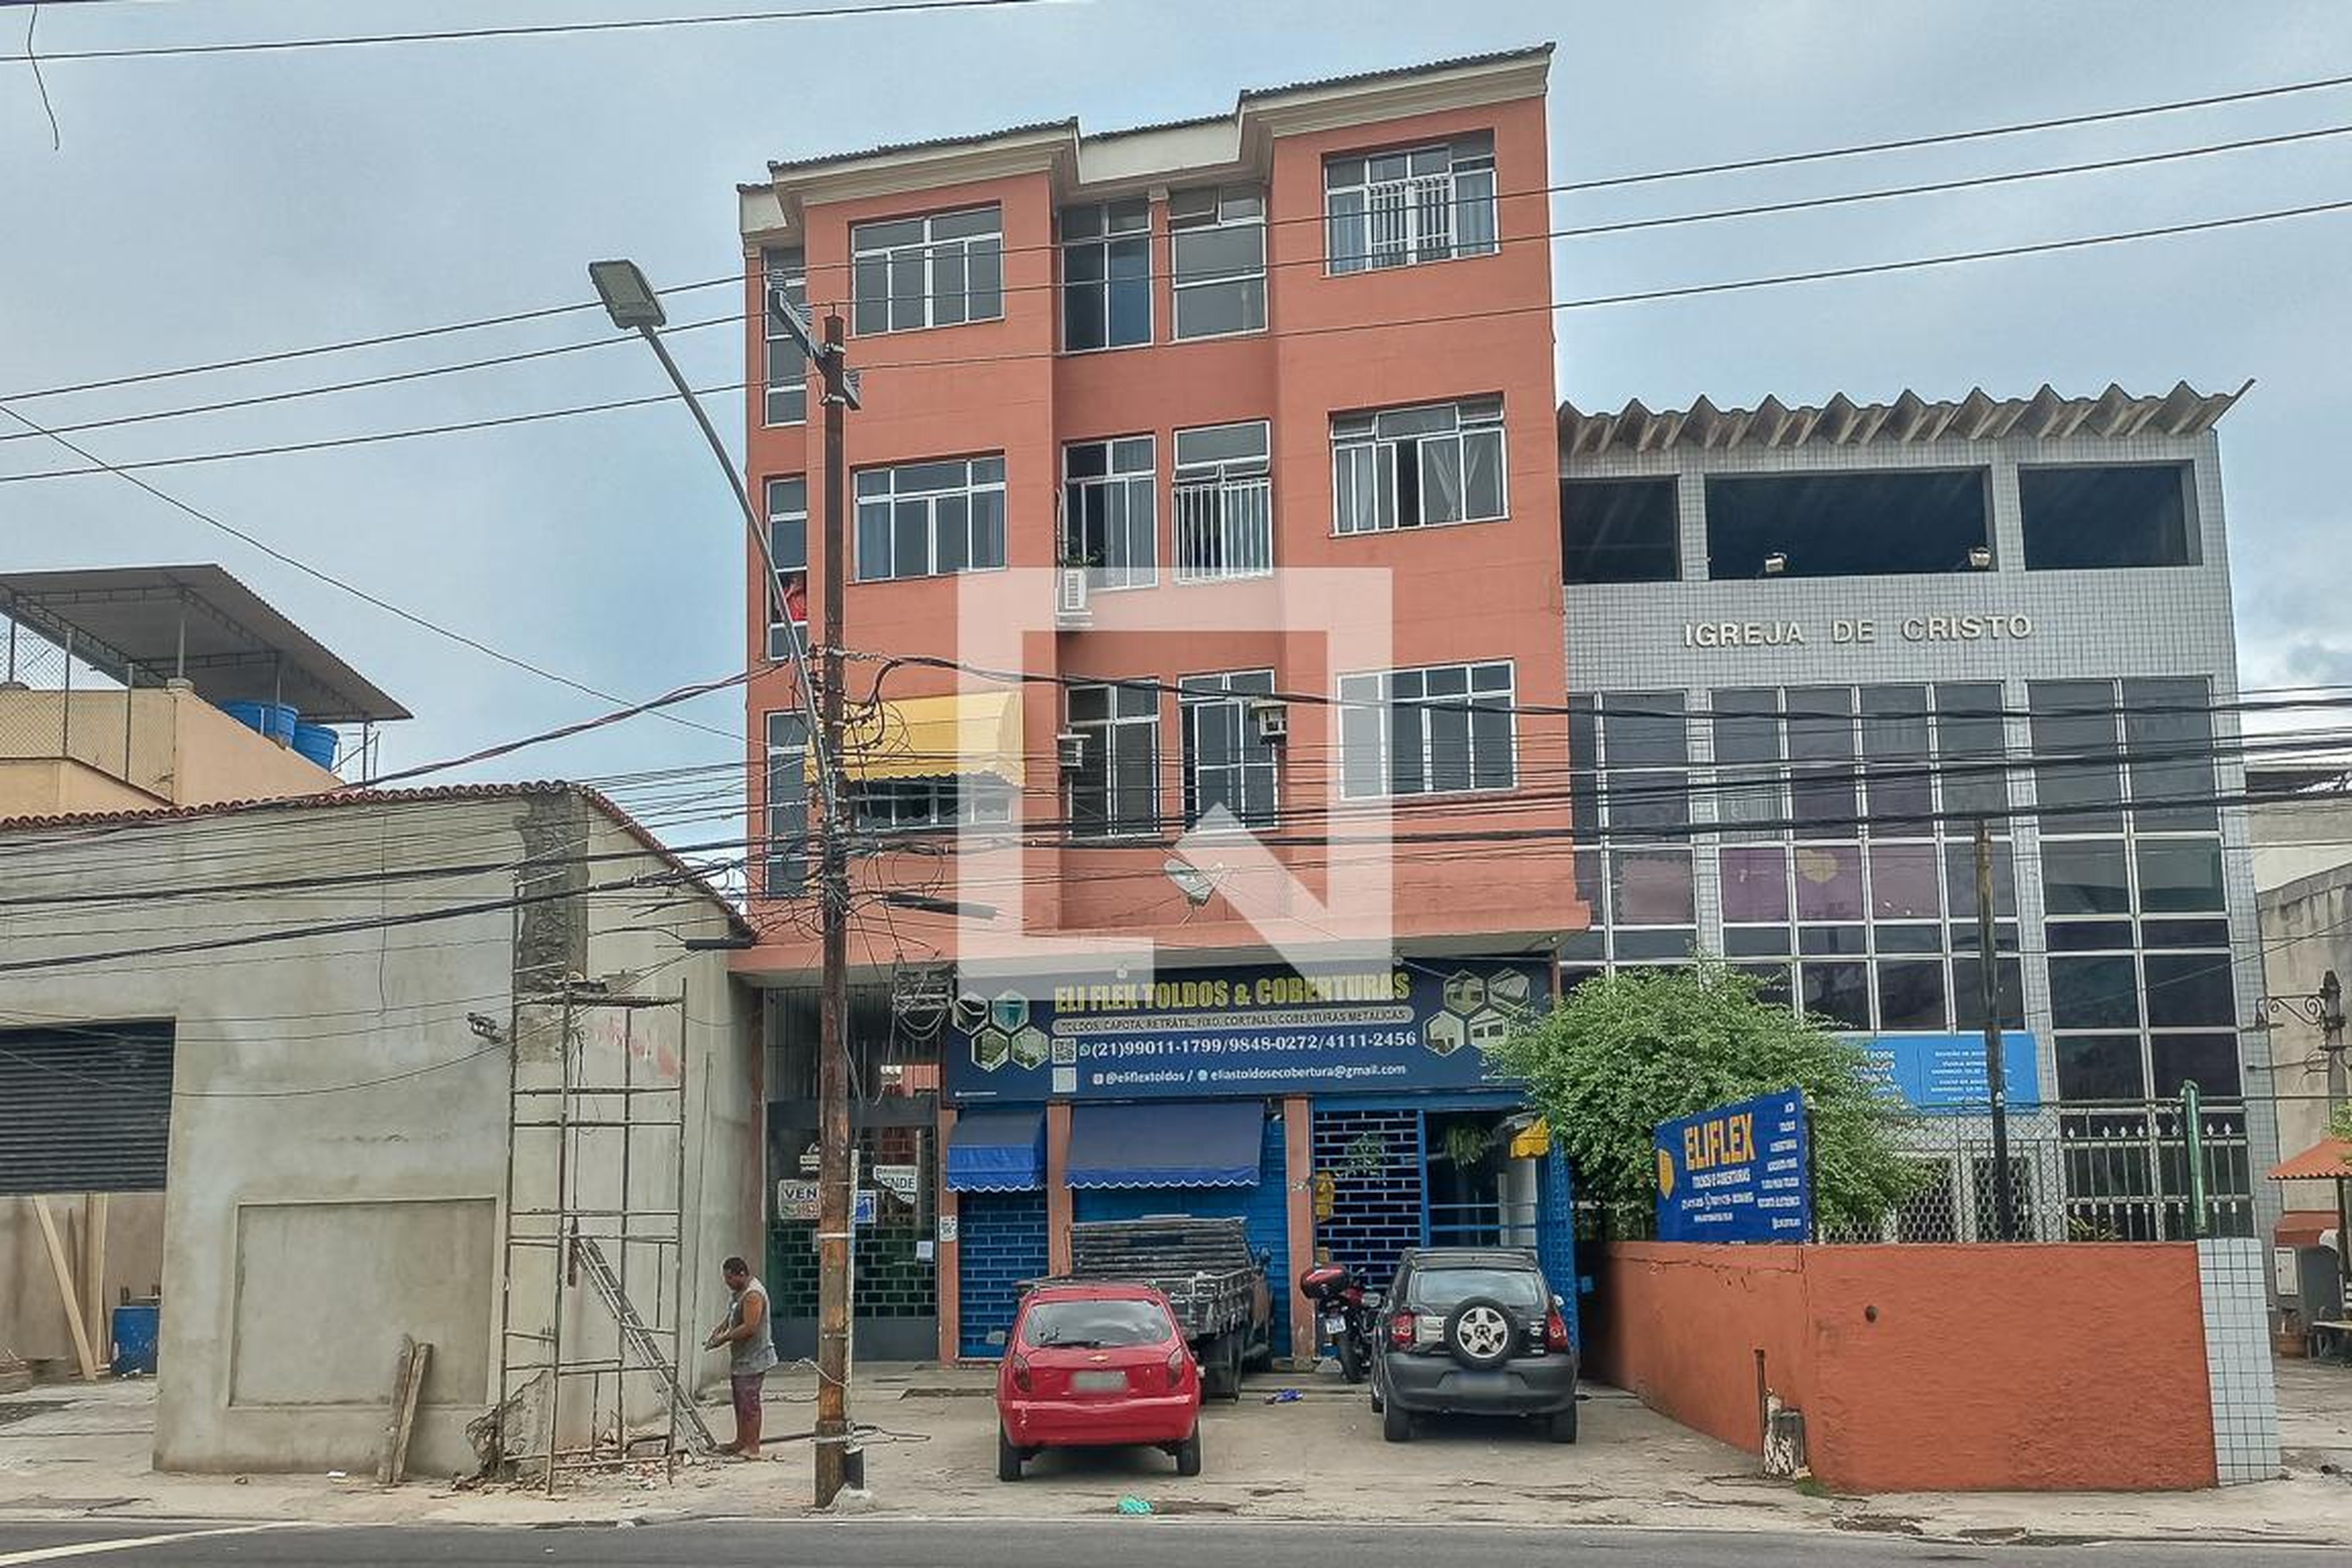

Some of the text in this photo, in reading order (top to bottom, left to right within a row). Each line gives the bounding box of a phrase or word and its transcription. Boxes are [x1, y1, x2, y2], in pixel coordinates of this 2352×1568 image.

[1684, 612, 2033, 647] IGREJA DE CRISTO
[1055, 984, 1085, 1013] ELI
[1142, 979, 1228, 1009] TOLDOS
[1234, 982, 1252, 1006] &
[1684, 1112, 1755, 1171] ELIFLEX
